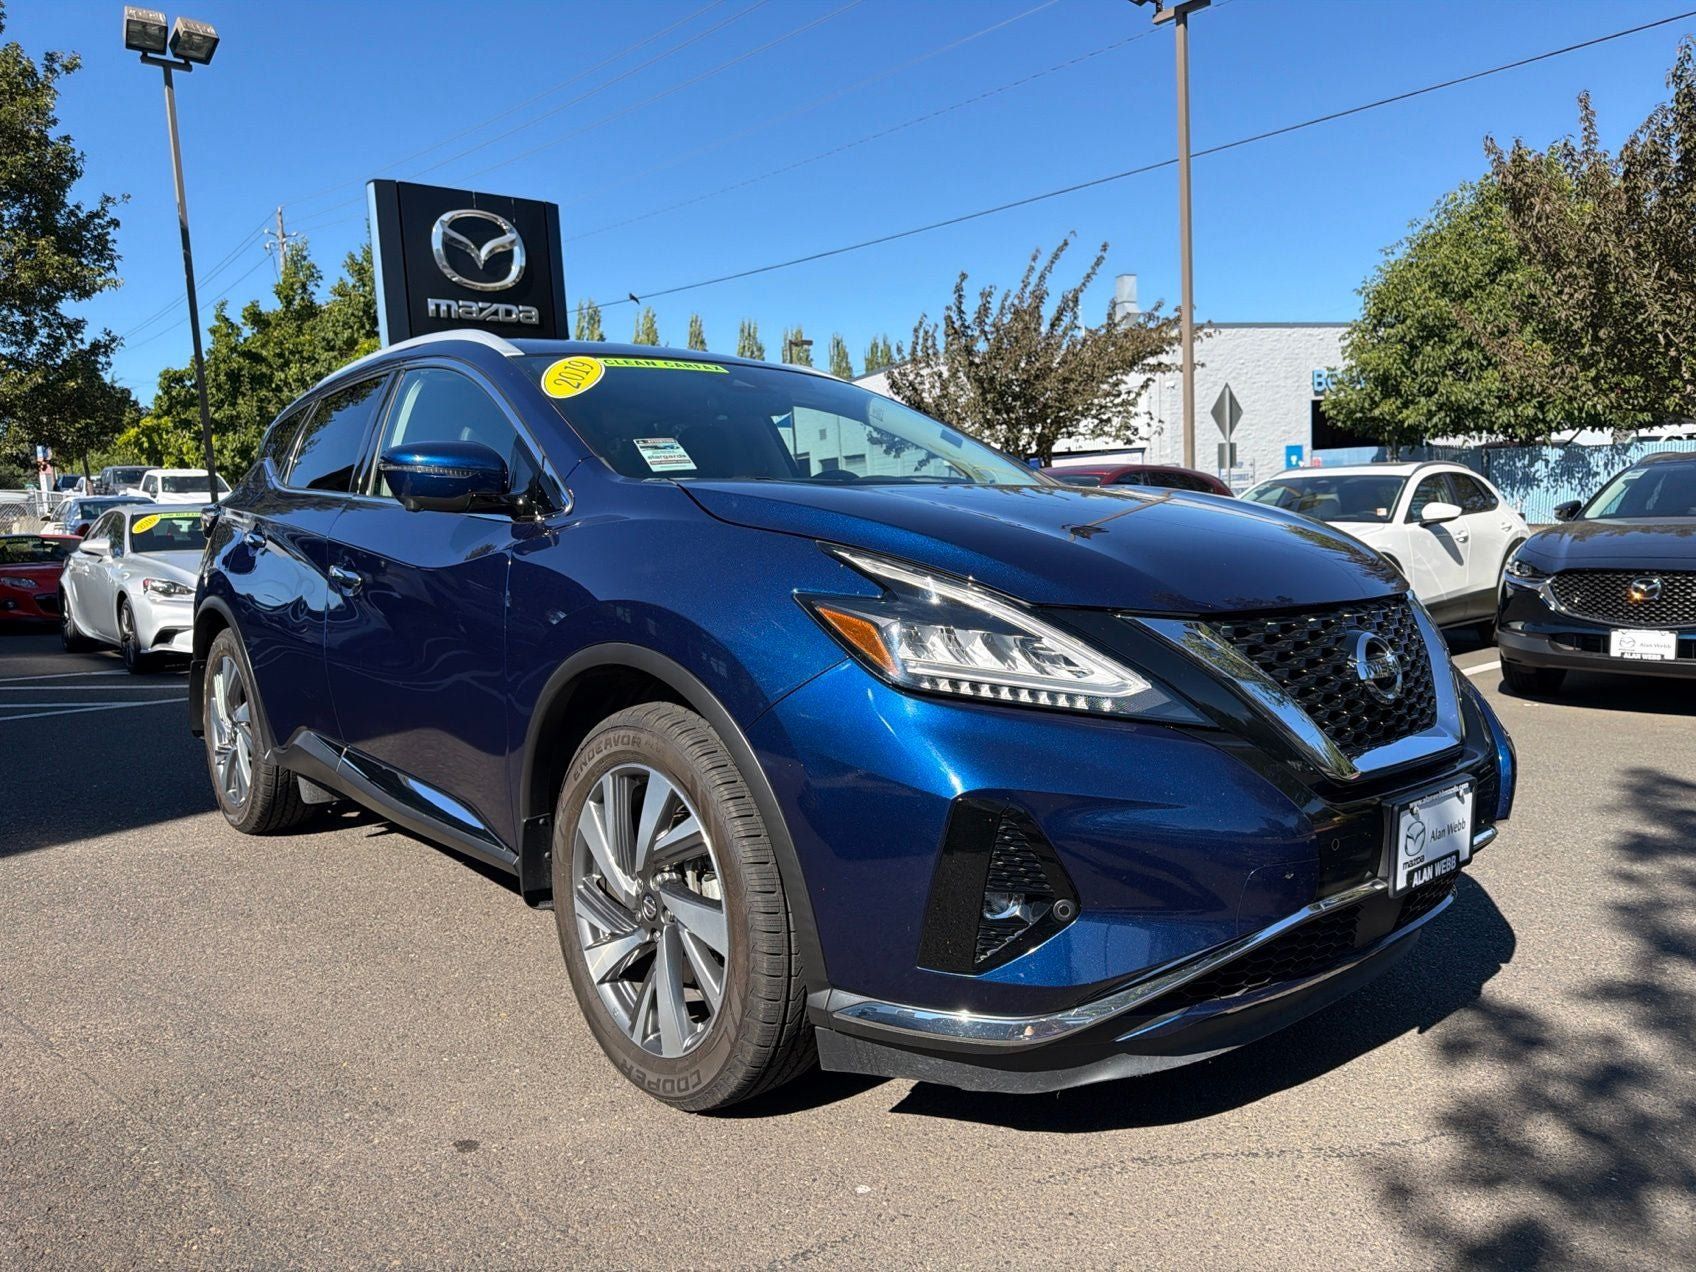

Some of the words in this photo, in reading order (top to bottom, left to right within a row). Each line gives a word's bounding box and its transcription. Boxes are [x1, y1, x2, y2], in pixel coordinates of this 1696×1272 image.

[553, 360, 594, 389] 2019
[603, 359, 657, 367] CLEAN
[663, 361, 722, 371] CARFAX
[573, 734, 642, 781] ENDEAVOR
[1430, 828, 1446, 842] Alan
[1447, 818, 1466, 836] Webb
[1412, 865, 1433, 888] ALAN
[1434, 855, 1457, 877] WEBB
[620, 1058, 702, 1094] COOPER
